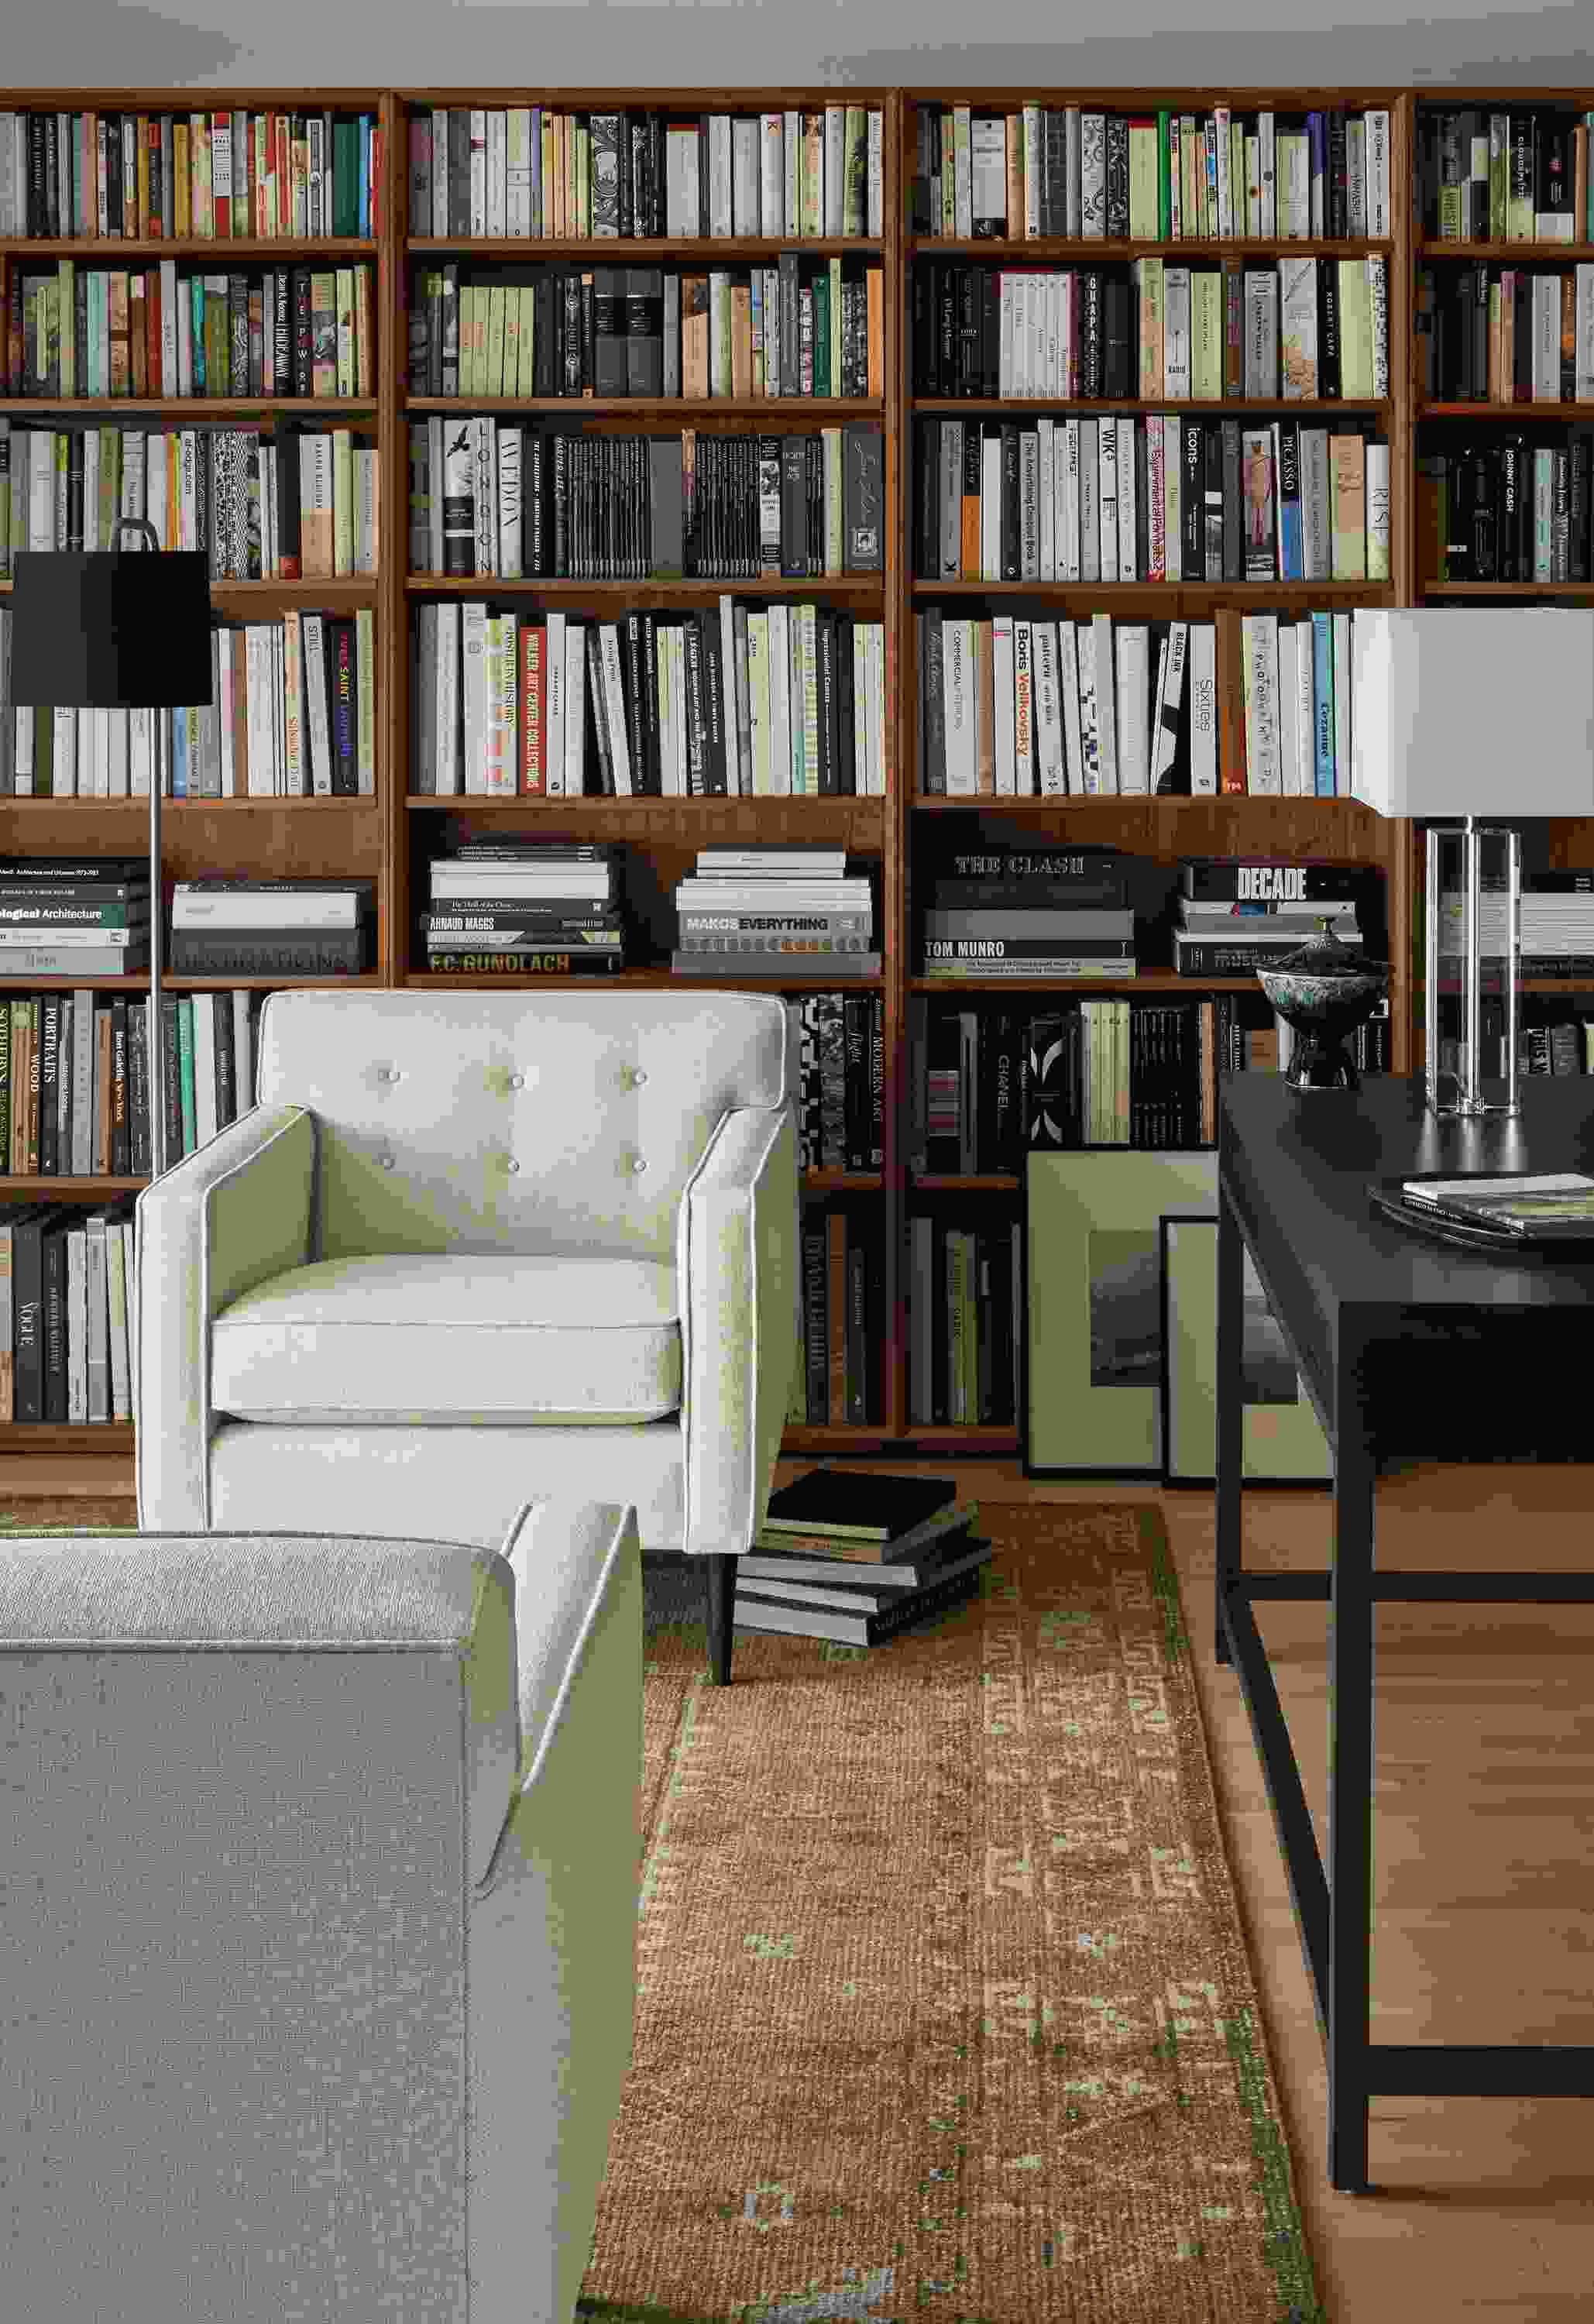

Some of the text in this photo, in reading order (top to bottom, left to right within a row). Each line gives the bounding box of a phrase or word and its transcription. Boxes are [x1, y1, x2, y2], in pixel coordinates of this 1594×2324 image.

[1187, 428, 1200, 463] icons
[1283, 436, 1295, 490] PICASSO
[526, 633, 539, 788] WALKER ART CENTER COLLECTIONS
[1016, 628, 1029, 757] Boris Velikovsky
[1201, 680, 1213, 731] Sixties
[954, 855, 1084, 875] THE CLASH
[1238, 867, 1307, 900] DECADE
[43, 909, 103, 920] Architecture
[739, 917, 828, 930] EVERYTHING
[925, 941, 1005, 957] TOM MUNRO
[43, 1007, 57, 1084] PORTRAITS
[29, 1054, 40, 1093] WOOD
[873, 1037, 886, 1122] MODERN ART
[998, 1054, 1009, 1112] CHANEL
